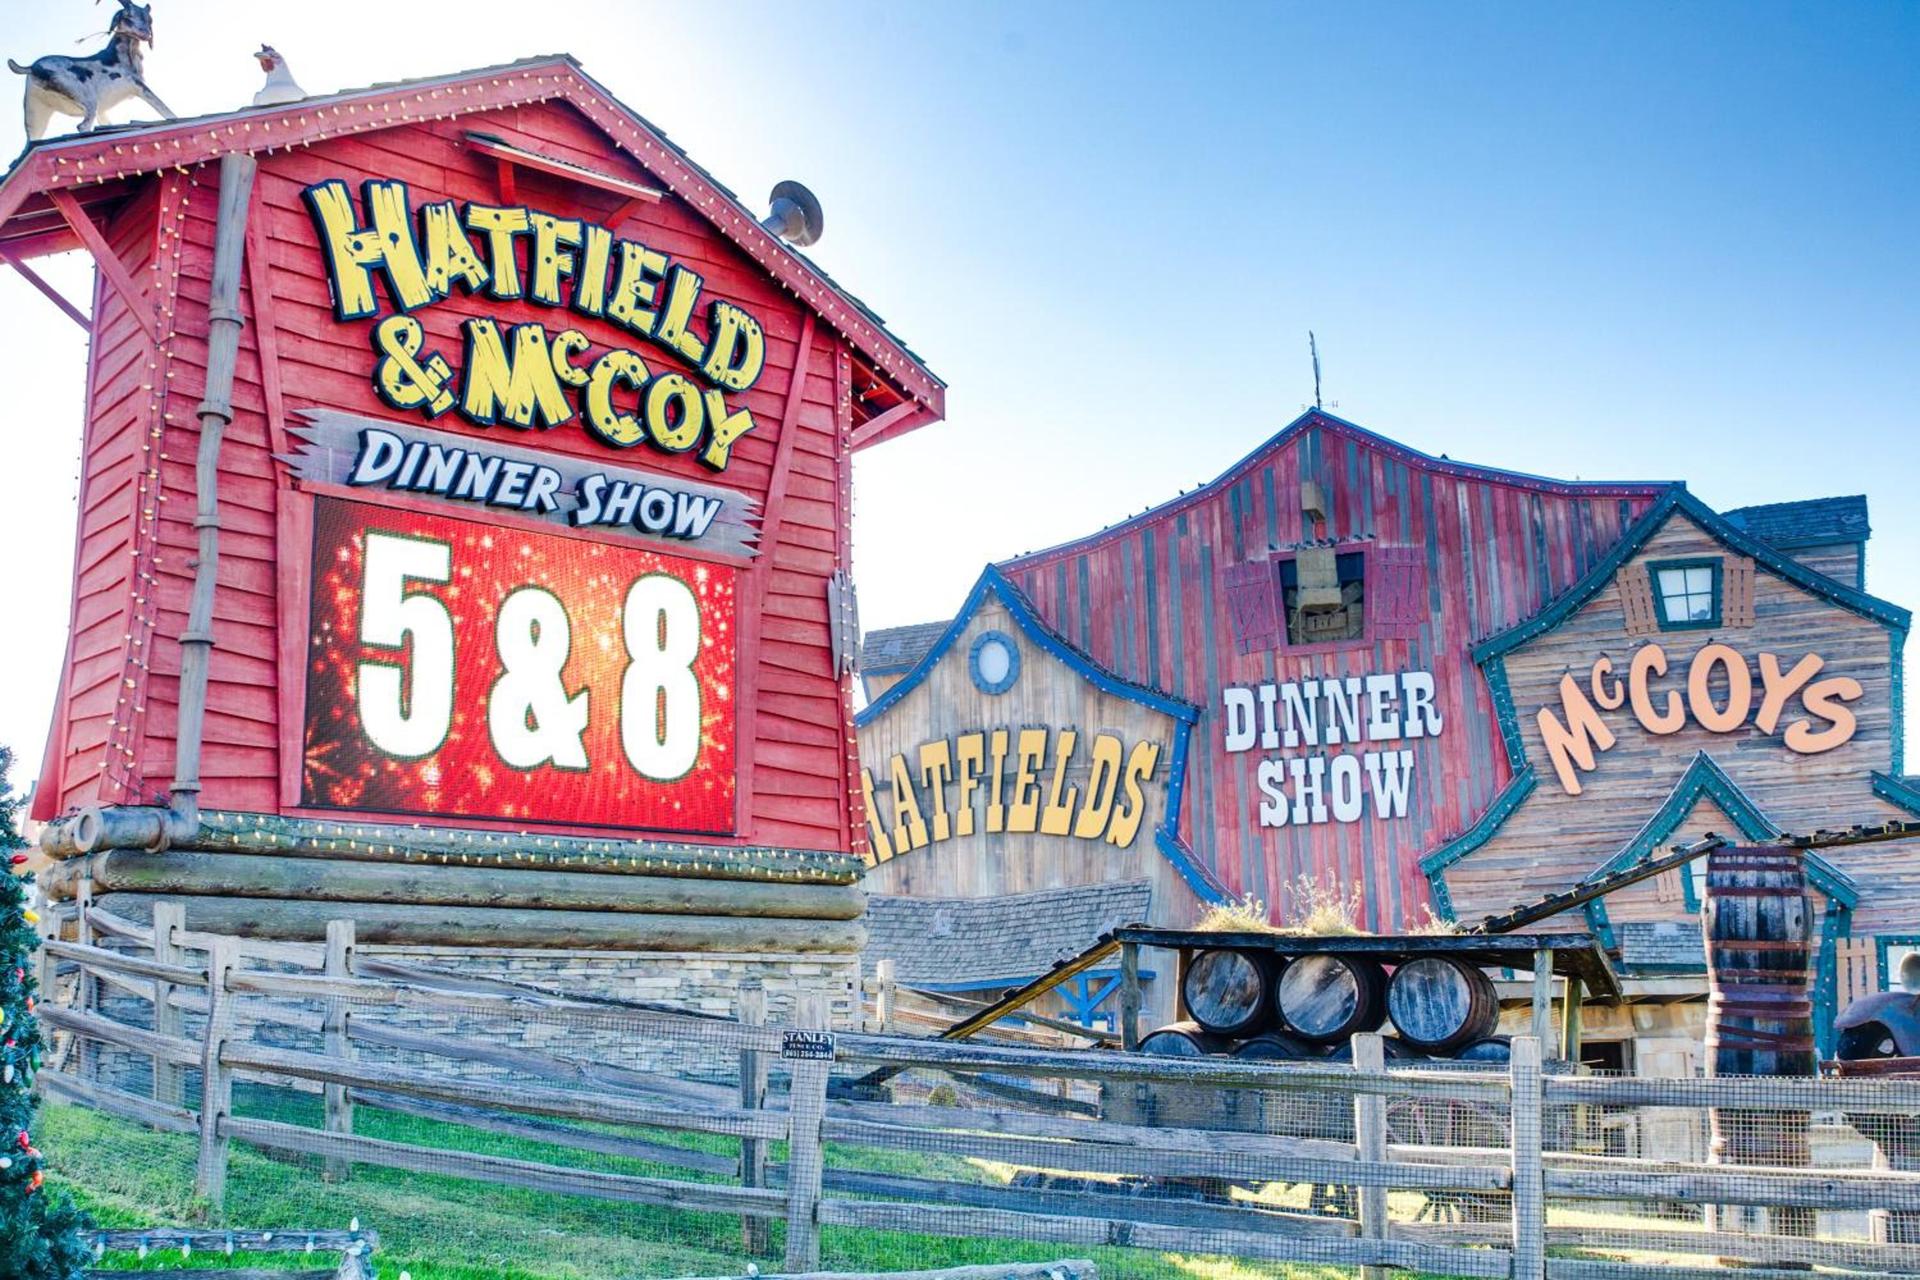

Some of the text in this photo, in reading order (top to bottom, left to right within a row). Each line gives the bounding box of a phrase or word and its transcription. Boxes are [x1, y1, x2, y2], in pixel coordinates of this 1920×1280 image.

[304, 180, 766, 392] HATFIELD
[371, 315, 455, 418] &
[349, 430, 721, 541] DINNER SHOW
[354, 528, 702, 783] 5 & 8
[1223, 671, 1443, 752] DINNER
[1257, 750, 1414, 827] SHOW
[783, 1032, 834, 1045] STANLEY
